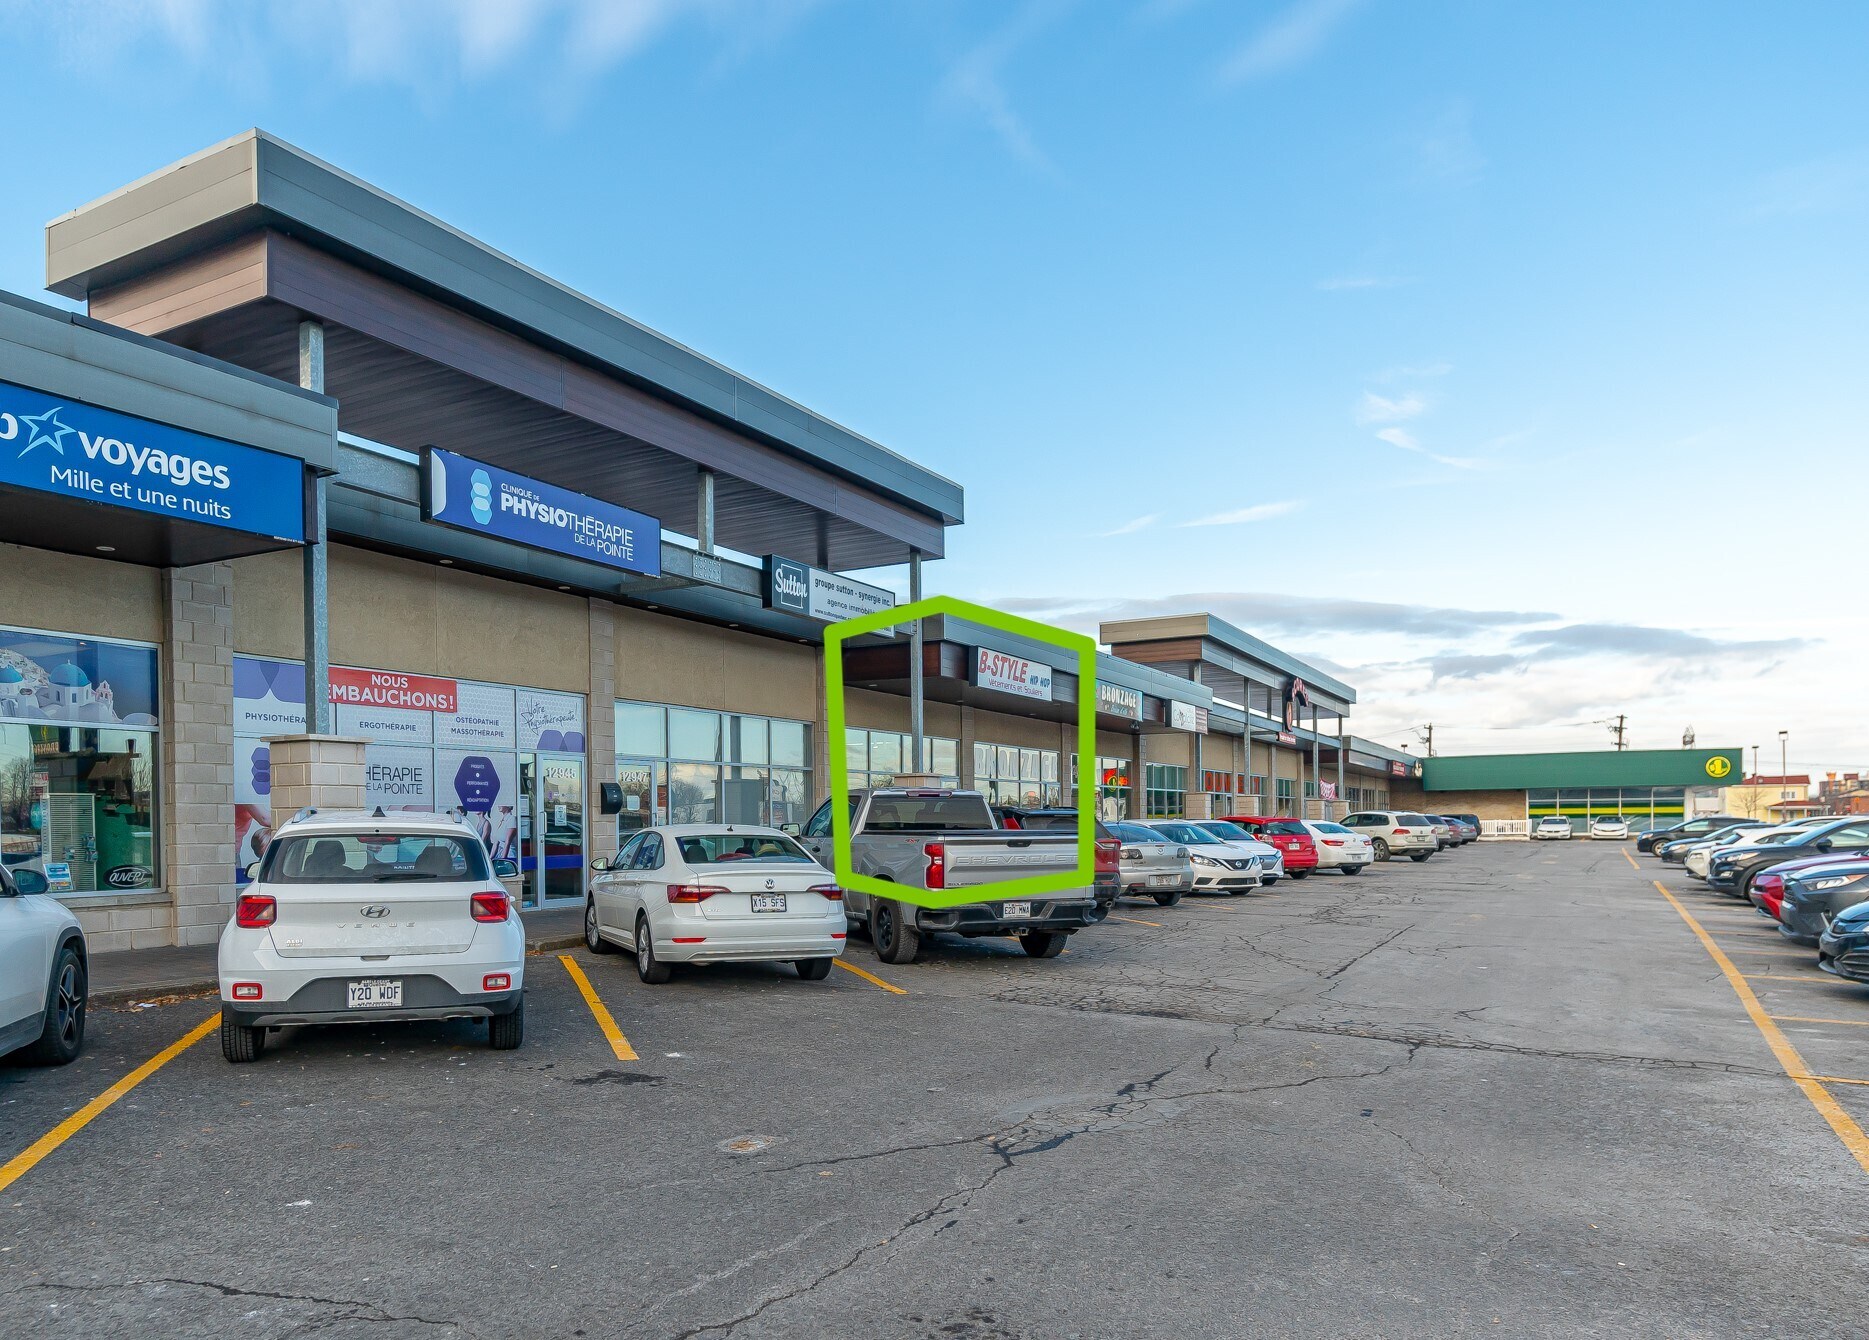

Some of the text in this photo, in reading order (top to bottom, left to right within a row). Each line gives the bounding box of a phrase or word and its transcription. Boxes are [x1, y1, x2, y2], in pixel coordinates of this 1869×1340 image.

[78, 431, 231, 489] voyages
[51, 465, 231, 520] Mille et une nuits
[501, 483, 540, 502] CLINIQUE DE
[501, 493, 634, 548] PHYSIOTHÉRAPIE
[574, 533, 634, 562] DE LA POINTE
[775, 568, 808, 598] Sutton
[814, 577, 835, 592] groupe
[836, 584, 854, 597] sutton
[858, 591, 881, 605] synergie
[882, 596, 892, 607] inc.
[827, 598, 848, 611] agence
[979, 651, 1029, 683] B-STYLE
[371, 674, 408, 688] NOUS
[1017, 685, 1023, 693] et
[1024, 686, 1043, 697] Souliers
[1101, 685, 1137, 708] BRONZAGE
[245, 712, 306, 724] PHYSIOTHÉRA
[456, 716, 500, 726] OSTÉOPATHIE
[360, 721, 416, 732] ERGOTHÉRAPIE
[451, 728, 504, 737] MASSOTHÉRAPIE
[546, 767, 576, 778] 12945
[620, 771, 648, 782] 12947
[372, 783, 383, 791] LA
[384, 783, 423, 794] POINTE
[1205, 771, 1260, 794] OUVET
[109, 871, 147, 882] OUVERT
[753, 898, 785, 907] X15 SFS
[1004, 907, 1016, 915] E20
[350, 985, 400, 1001] Y20 WDF
